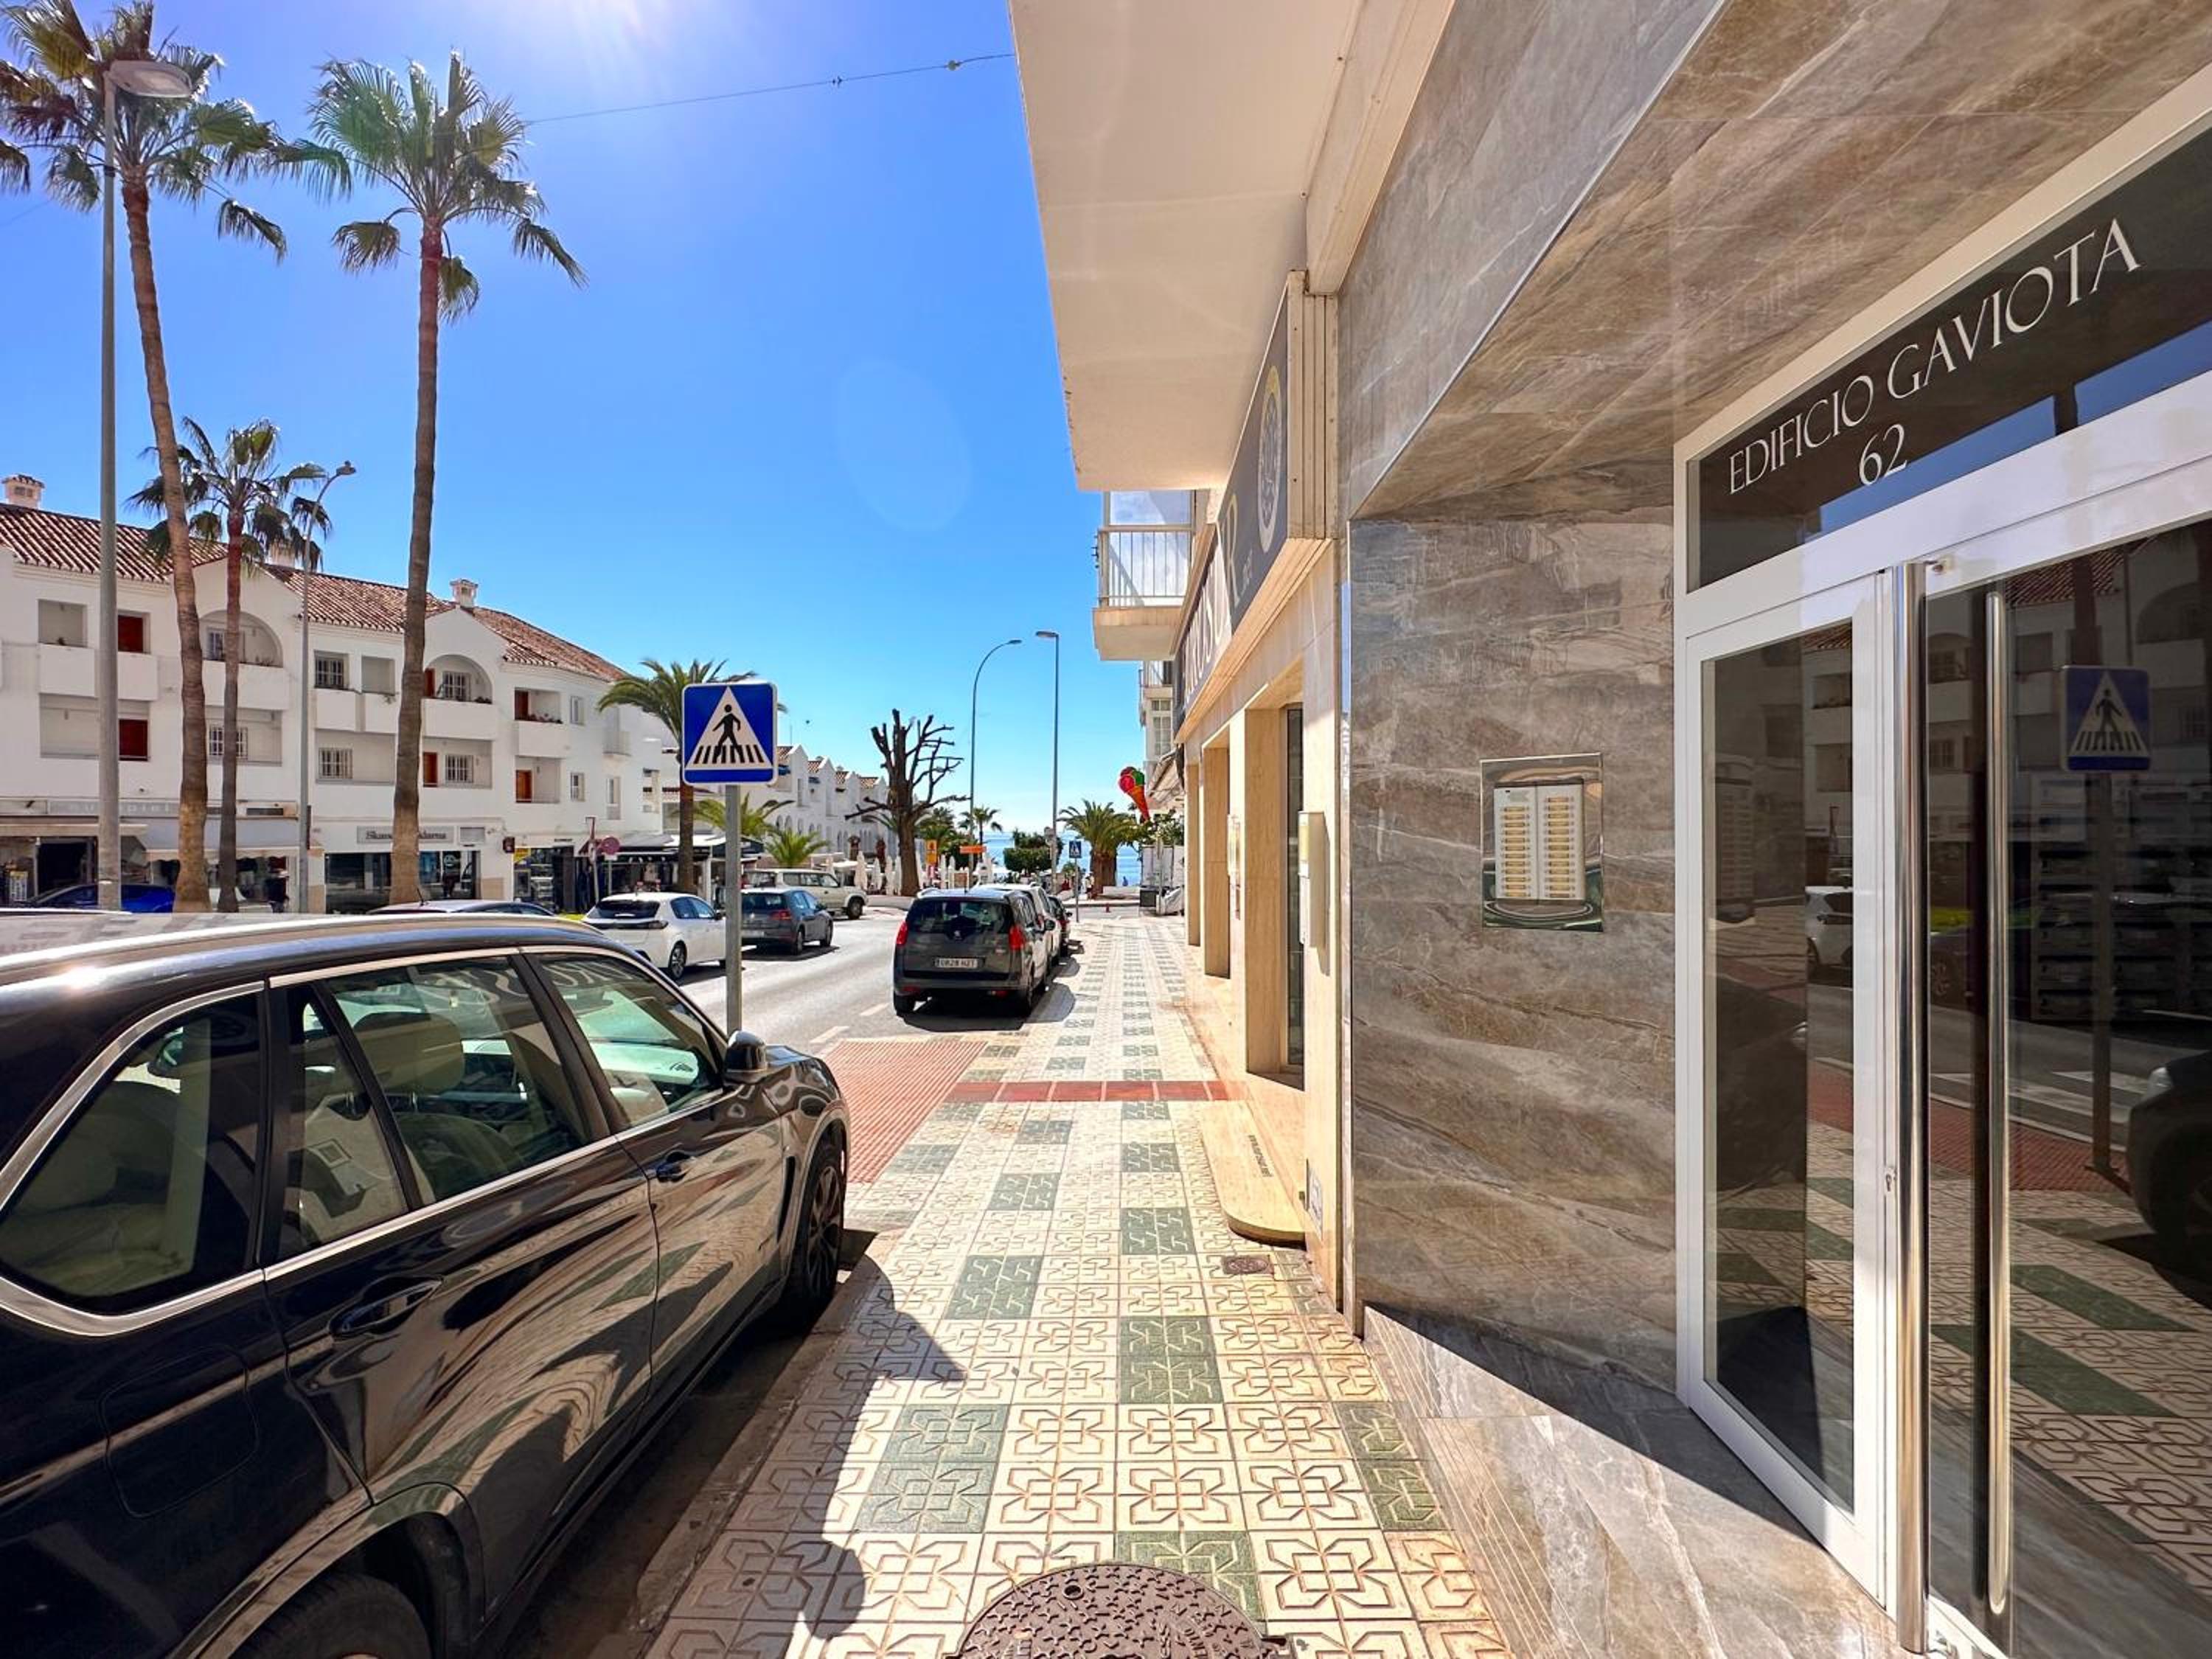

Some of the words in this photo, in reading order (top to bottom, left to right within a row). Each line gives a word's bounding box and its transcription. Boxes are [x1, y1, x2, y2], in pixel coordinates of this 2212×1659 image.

[1729, 375, 1874, 495] EDIFICIO
[1888, 218, 2140, 399] GAVIOTA
[1858, 423, 1908, 486] 62
